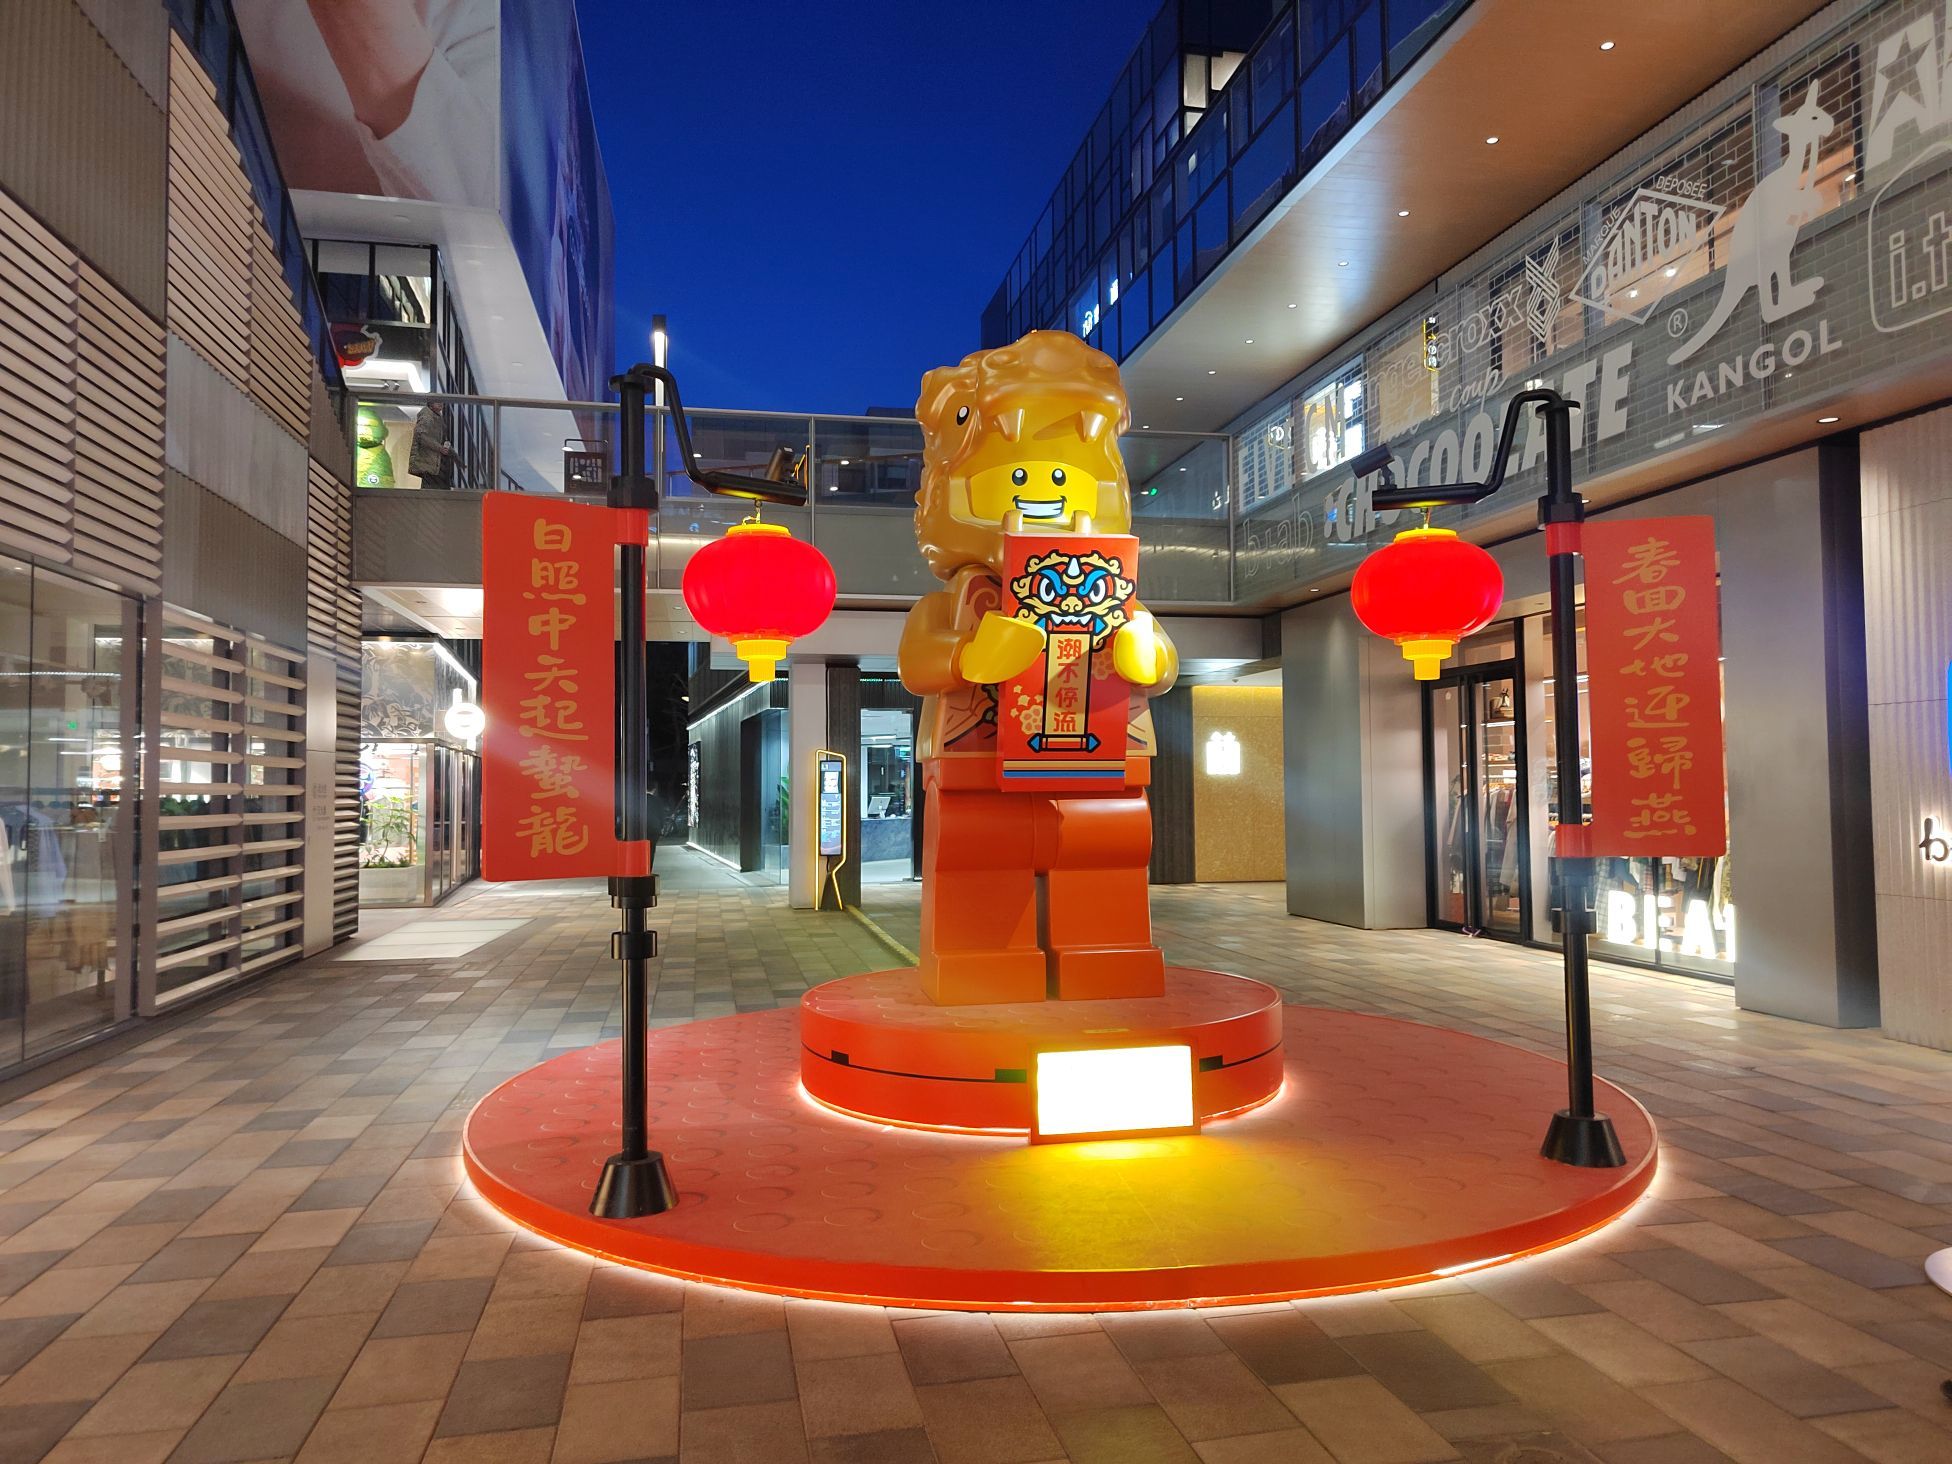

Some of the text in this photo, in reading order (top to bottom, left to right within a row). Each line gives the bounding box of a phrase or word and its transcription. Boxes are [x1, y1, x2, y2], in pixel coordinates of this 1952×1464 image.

[1864, 11, 1952, 172] A
[1583, 205, 1624, 265] MARQUE
[1591, 200, 1698, 300] DANTON
[1666, 319, 1843, 414] KANGOL
[1052, 637, 1083, 733] 潮不停流
